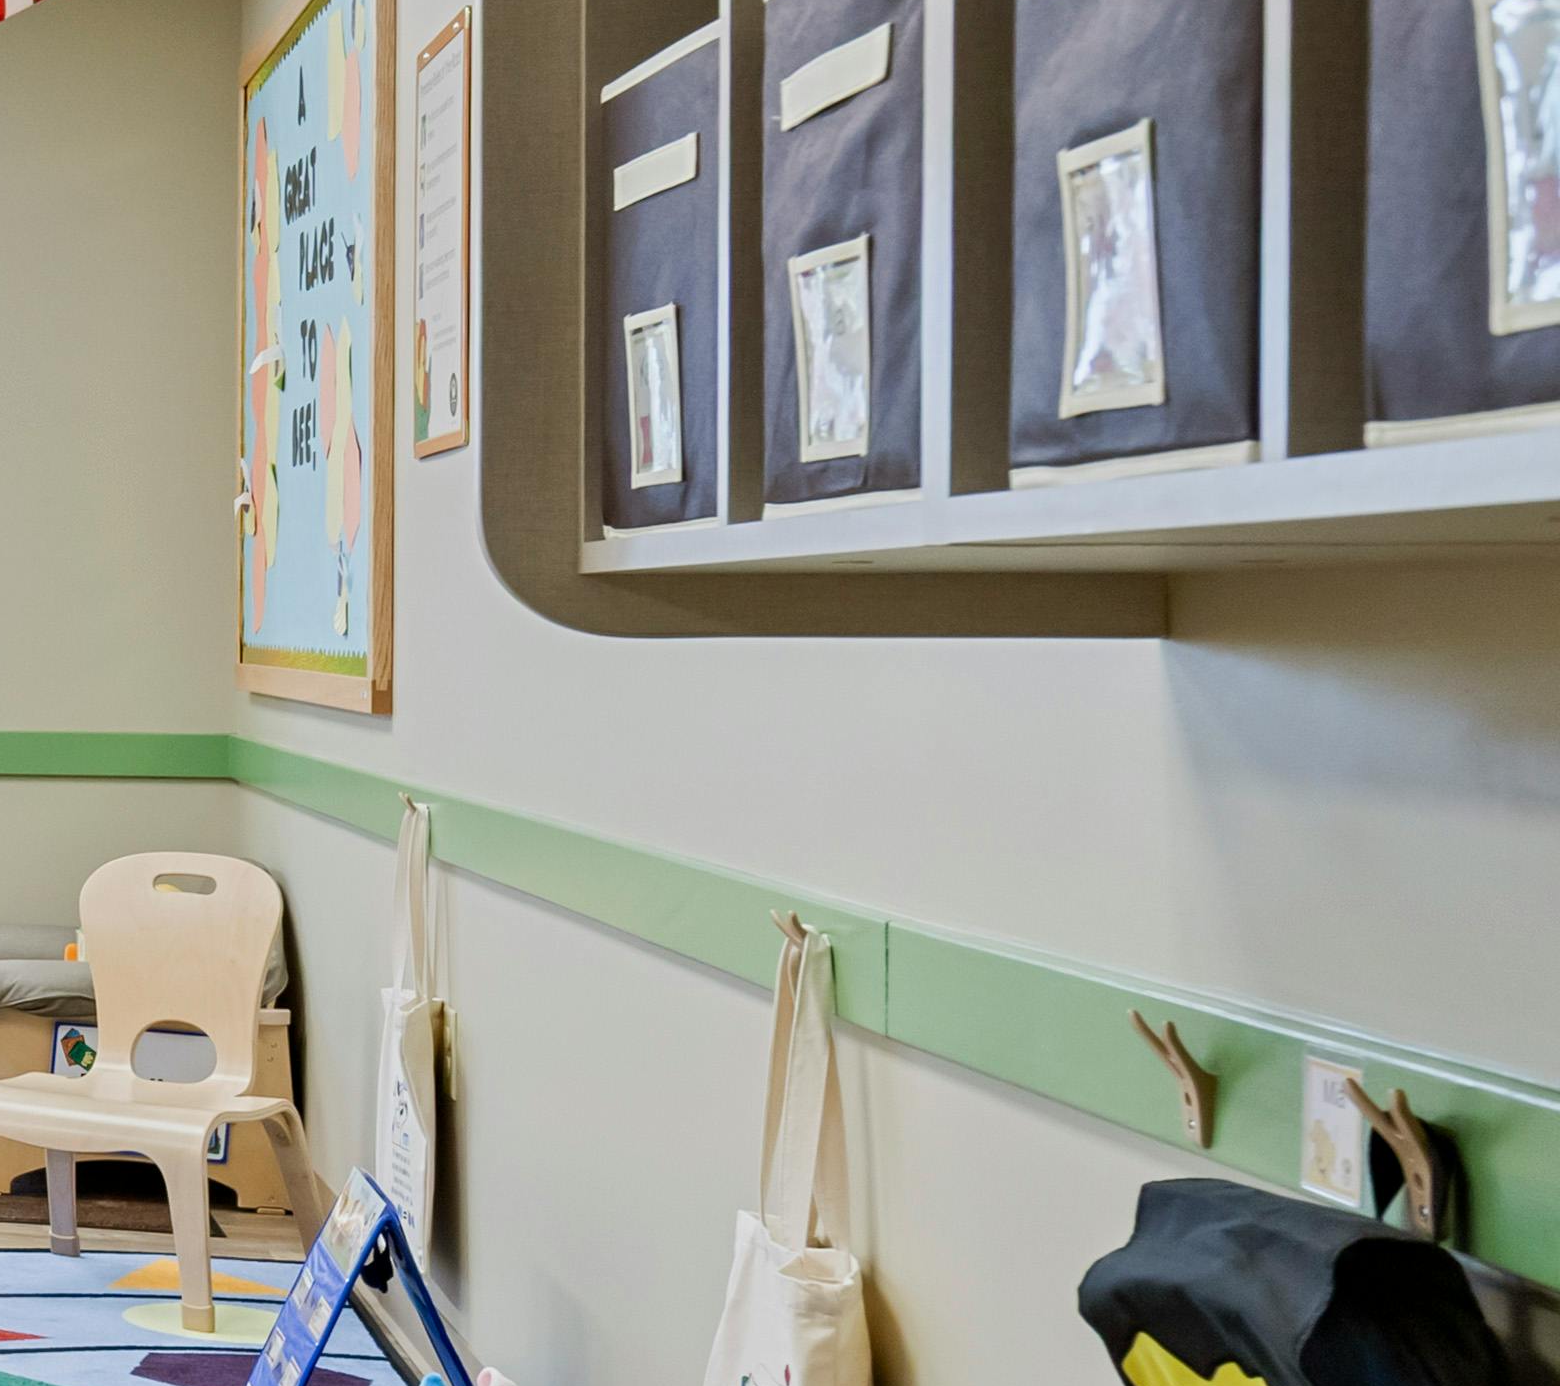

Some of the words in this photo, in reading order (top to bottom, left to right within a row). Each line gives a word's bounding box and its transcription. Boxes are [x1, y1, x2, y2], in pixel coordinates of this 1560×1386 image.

[297, 65, 307, 126] A
[284, 145, 317, 226] GREAT
[298, 216, 335, 292] PLACE
[300, 319, 317, 382] TO
[291, 398, 317, 471] BEE!
